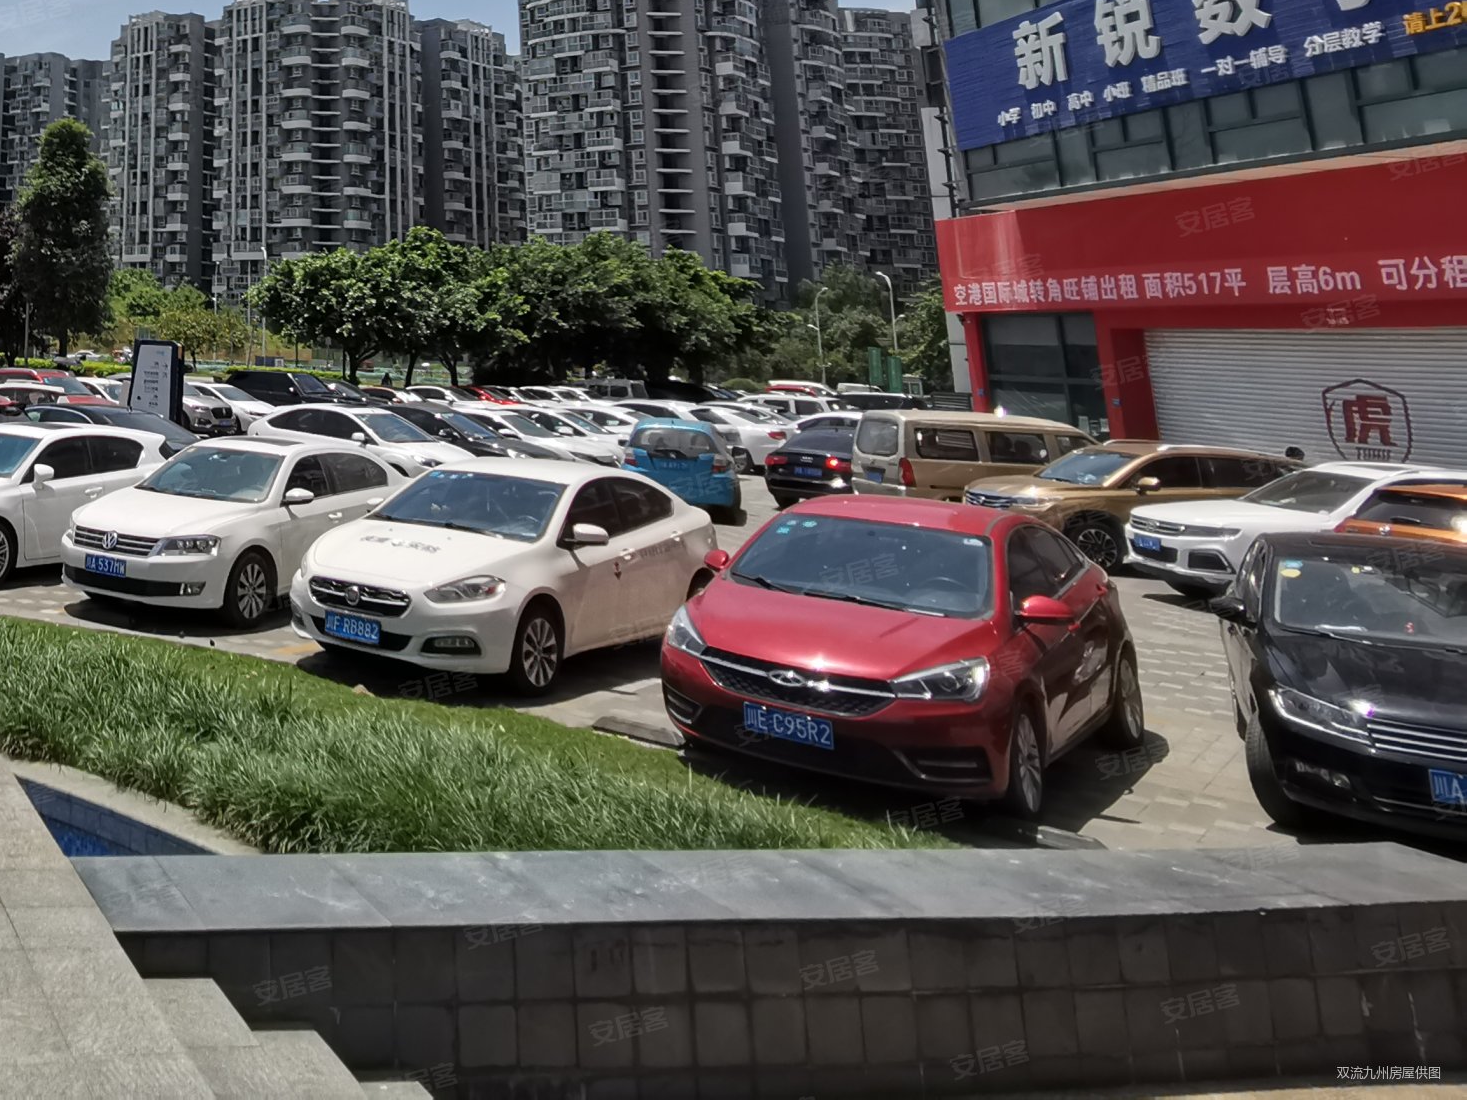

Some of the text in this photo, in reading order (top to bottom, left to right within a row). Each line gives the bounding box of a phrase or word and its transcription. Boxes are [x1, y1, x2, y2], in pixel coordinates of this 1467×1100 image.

[1200, 44, 1289, 77] 一对一辅导
[1304, 21, 1384, 57] 分层教学
[953, 274, 1139, 306] 空港国际城转角旺铺出租
[1142, 266, 1247, 299] 面积517平
[1266, 264, 1362, 295] 层高6m
[1342, 394, 1399, 447] 虎
